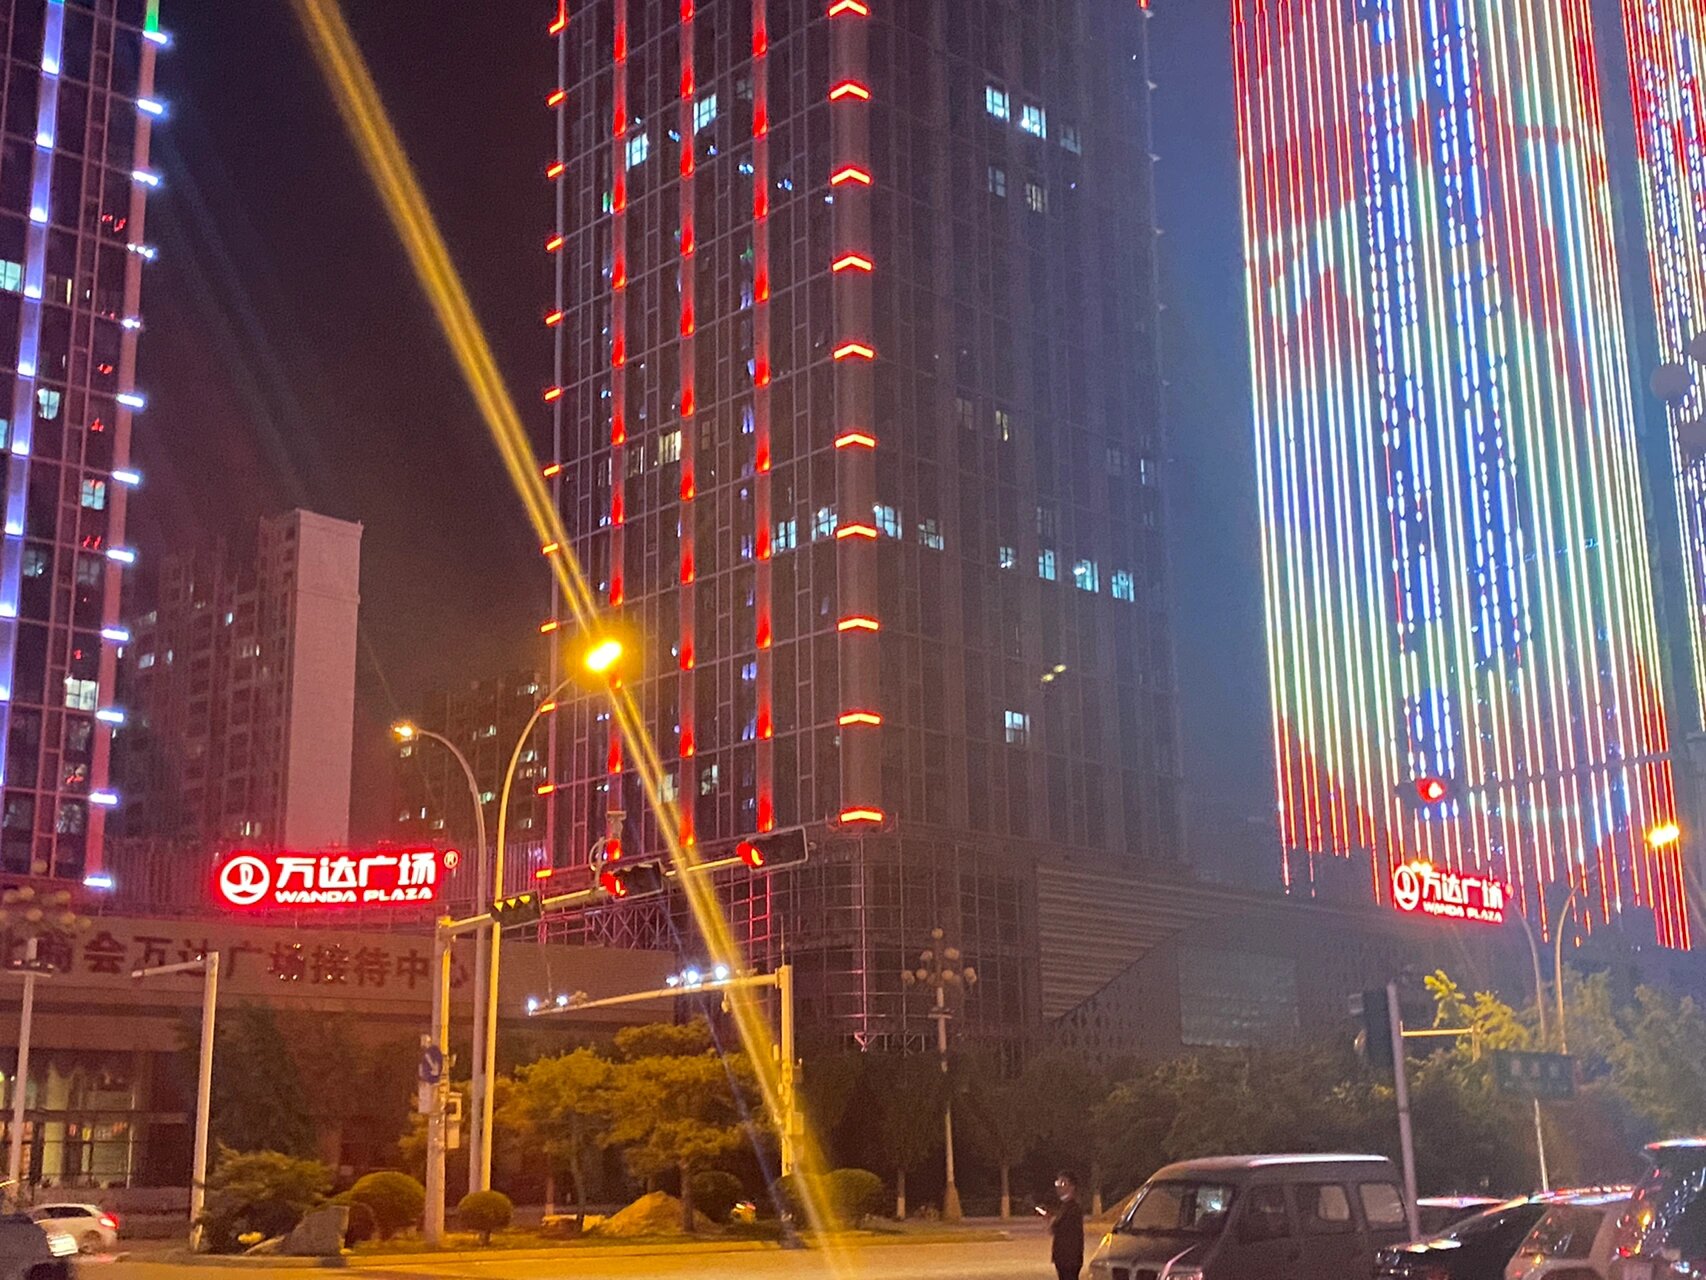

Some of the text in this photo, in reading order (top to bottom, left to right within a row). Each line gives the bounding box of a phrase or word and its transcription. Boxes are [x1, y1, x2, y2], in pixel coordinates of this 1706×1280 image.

[276, 853, 436, 888] 万达广场
[275, 888, 433, 903] WANDA PLAZA
[1421, 871, 1503, 909] 万达广场
[1466, 908, 1502, 922] PLAZA
